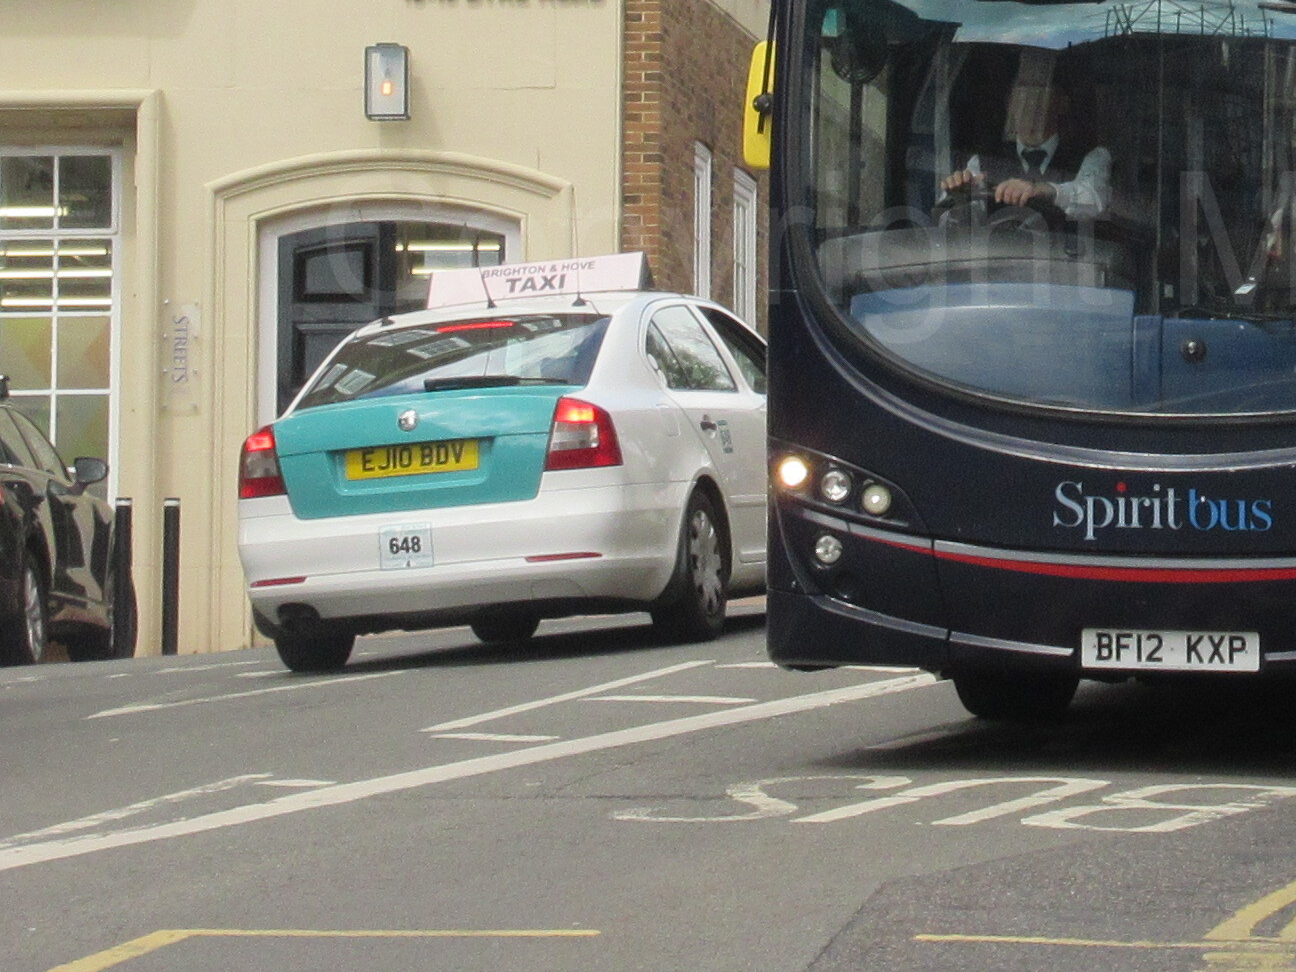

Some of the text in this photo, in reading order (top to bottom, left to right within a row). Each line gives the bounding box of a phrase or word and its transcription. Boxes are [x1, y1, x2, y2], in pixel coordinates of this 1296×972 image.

[482, 260, 596, 278] BRIGHTON & HOVE
[506, 273, 568, 293] TAXI
[172, 315, 189, 384] STREETS
[361, 441, 465, 472] EJ10 BDV
[1053, 480, 1274, 540] Spirit bus
[389, 535, 421, 555] 648
[1095, 631, 1247, 665] BF12 KXP
